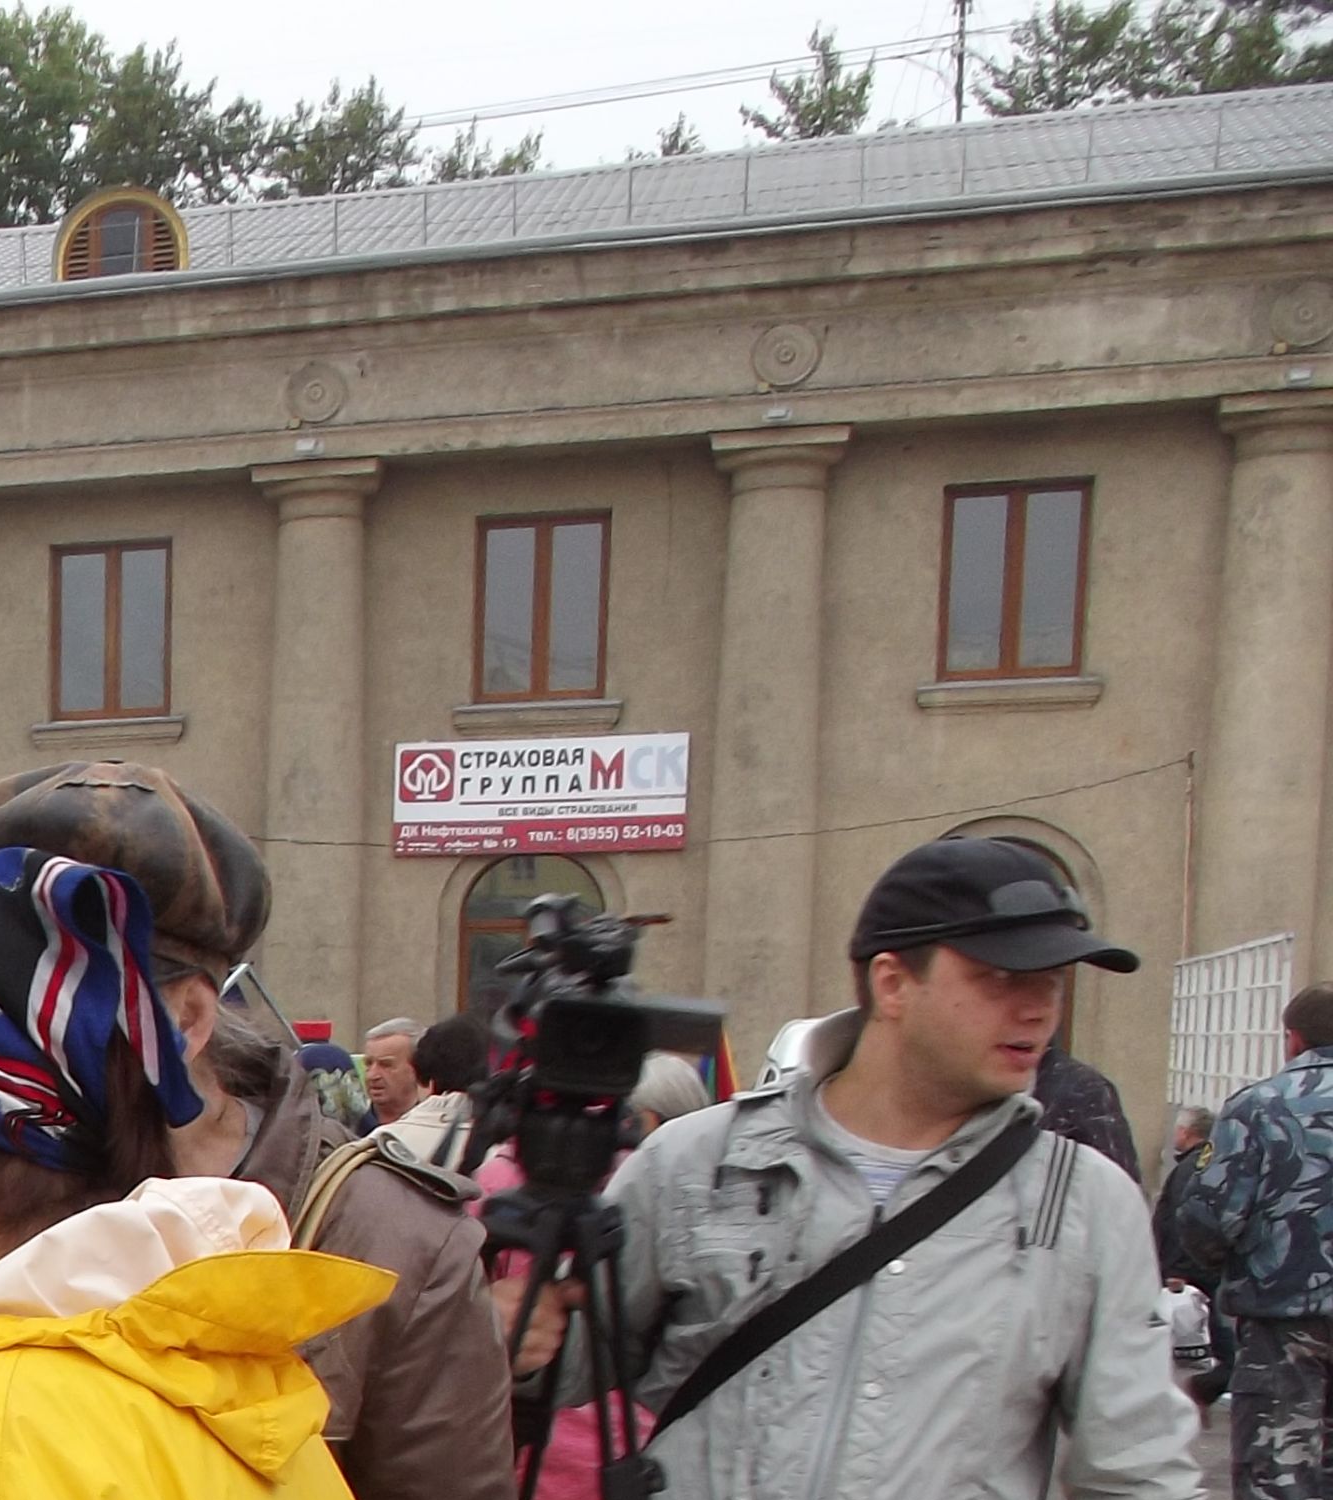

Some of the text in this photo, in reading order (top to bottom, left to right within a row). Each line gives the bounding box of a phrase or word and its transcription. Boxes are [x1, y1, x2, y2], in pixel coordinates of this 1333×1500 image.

[459, 744, 685, 791] СТРАХОВАЯ МСК
[459, 774, 584, 796] ГРУППА
[497, 803, 638, 817] ВСЕ ВИДЫ СТРАХОВАНИЯ
[565, 826, 619, 843] 8(3955)
[621, 823, 684, 839] 52-19-03
